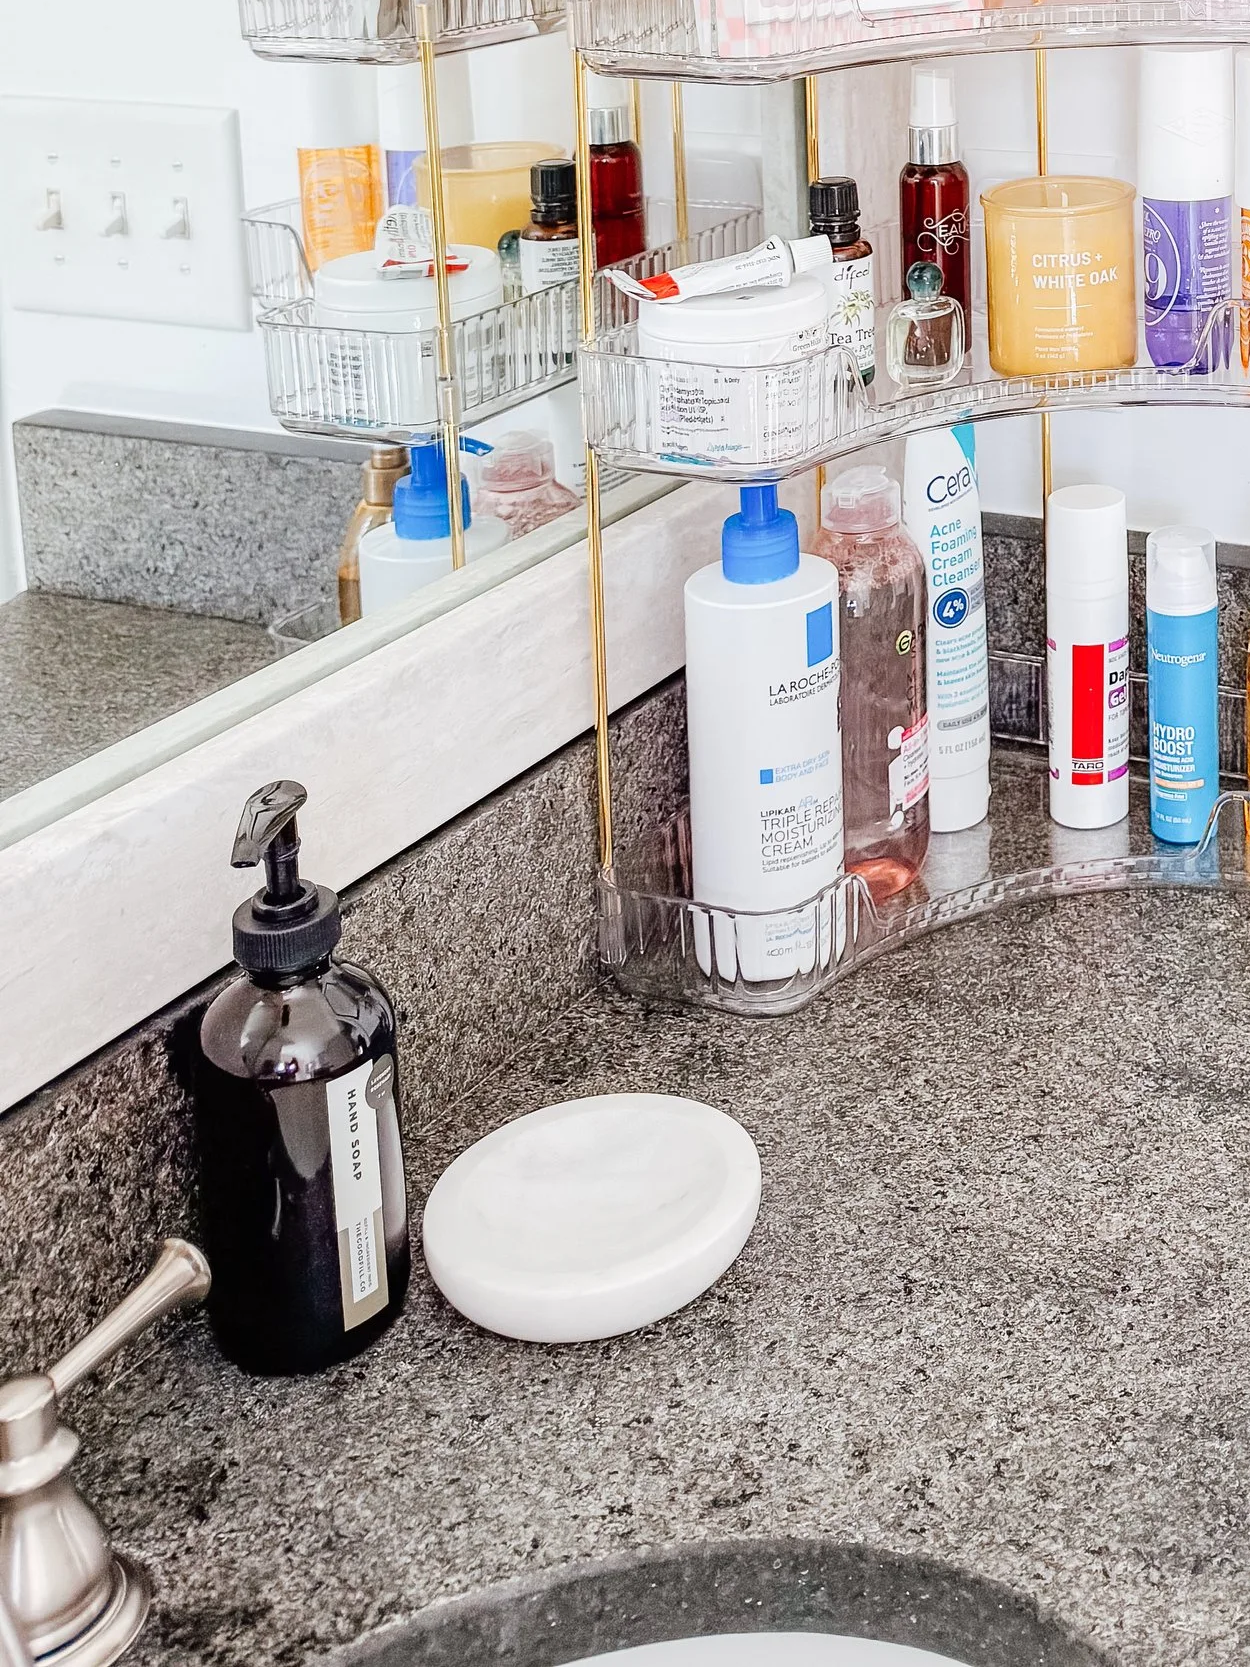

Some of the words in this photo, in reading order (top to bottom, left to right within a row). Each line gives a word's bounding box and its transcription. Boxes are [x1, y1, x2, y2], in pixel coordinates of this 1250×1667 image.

[938, 221, 967, 238] EAU
[1031, 251, 1092, 268] CITRUS
[1094, 252, 1103, 262] +
[1032, 273, 1086, 290] WHITE
[1089, 265, 1119, 286] OAK
[828, 332, 852, 345] Tea
[930, 518, 962, 539] Acne
[930, 525, 977, 555] Foaming
[932, 547, 973, 572] Cream
[932, 557, 981, 588] Cleanser
[942, 598, 965, 620] 4%
[769, 684, 787, 697] LA
[769, 687, 816, 707] LABORATOIRE
[1153, 721, 1195, 742] HYDRO
[1153, 739, 1194, 757] BOOST
[775, 762, 802, 775] EXTRA
[802, 756, 817, 768] DRY
[1072, 761, 1104, 770] TARO
[775, 770, 798, 784] BODY
[760, 805, 796, 818] LIPIKAR
[760, 809, 812, 831] TRIPLE
[761, 835, 814, 858] CREAM
[347, 1088, 360, 1133] HAND
[350, 1139, 363, 1182] SOAP
